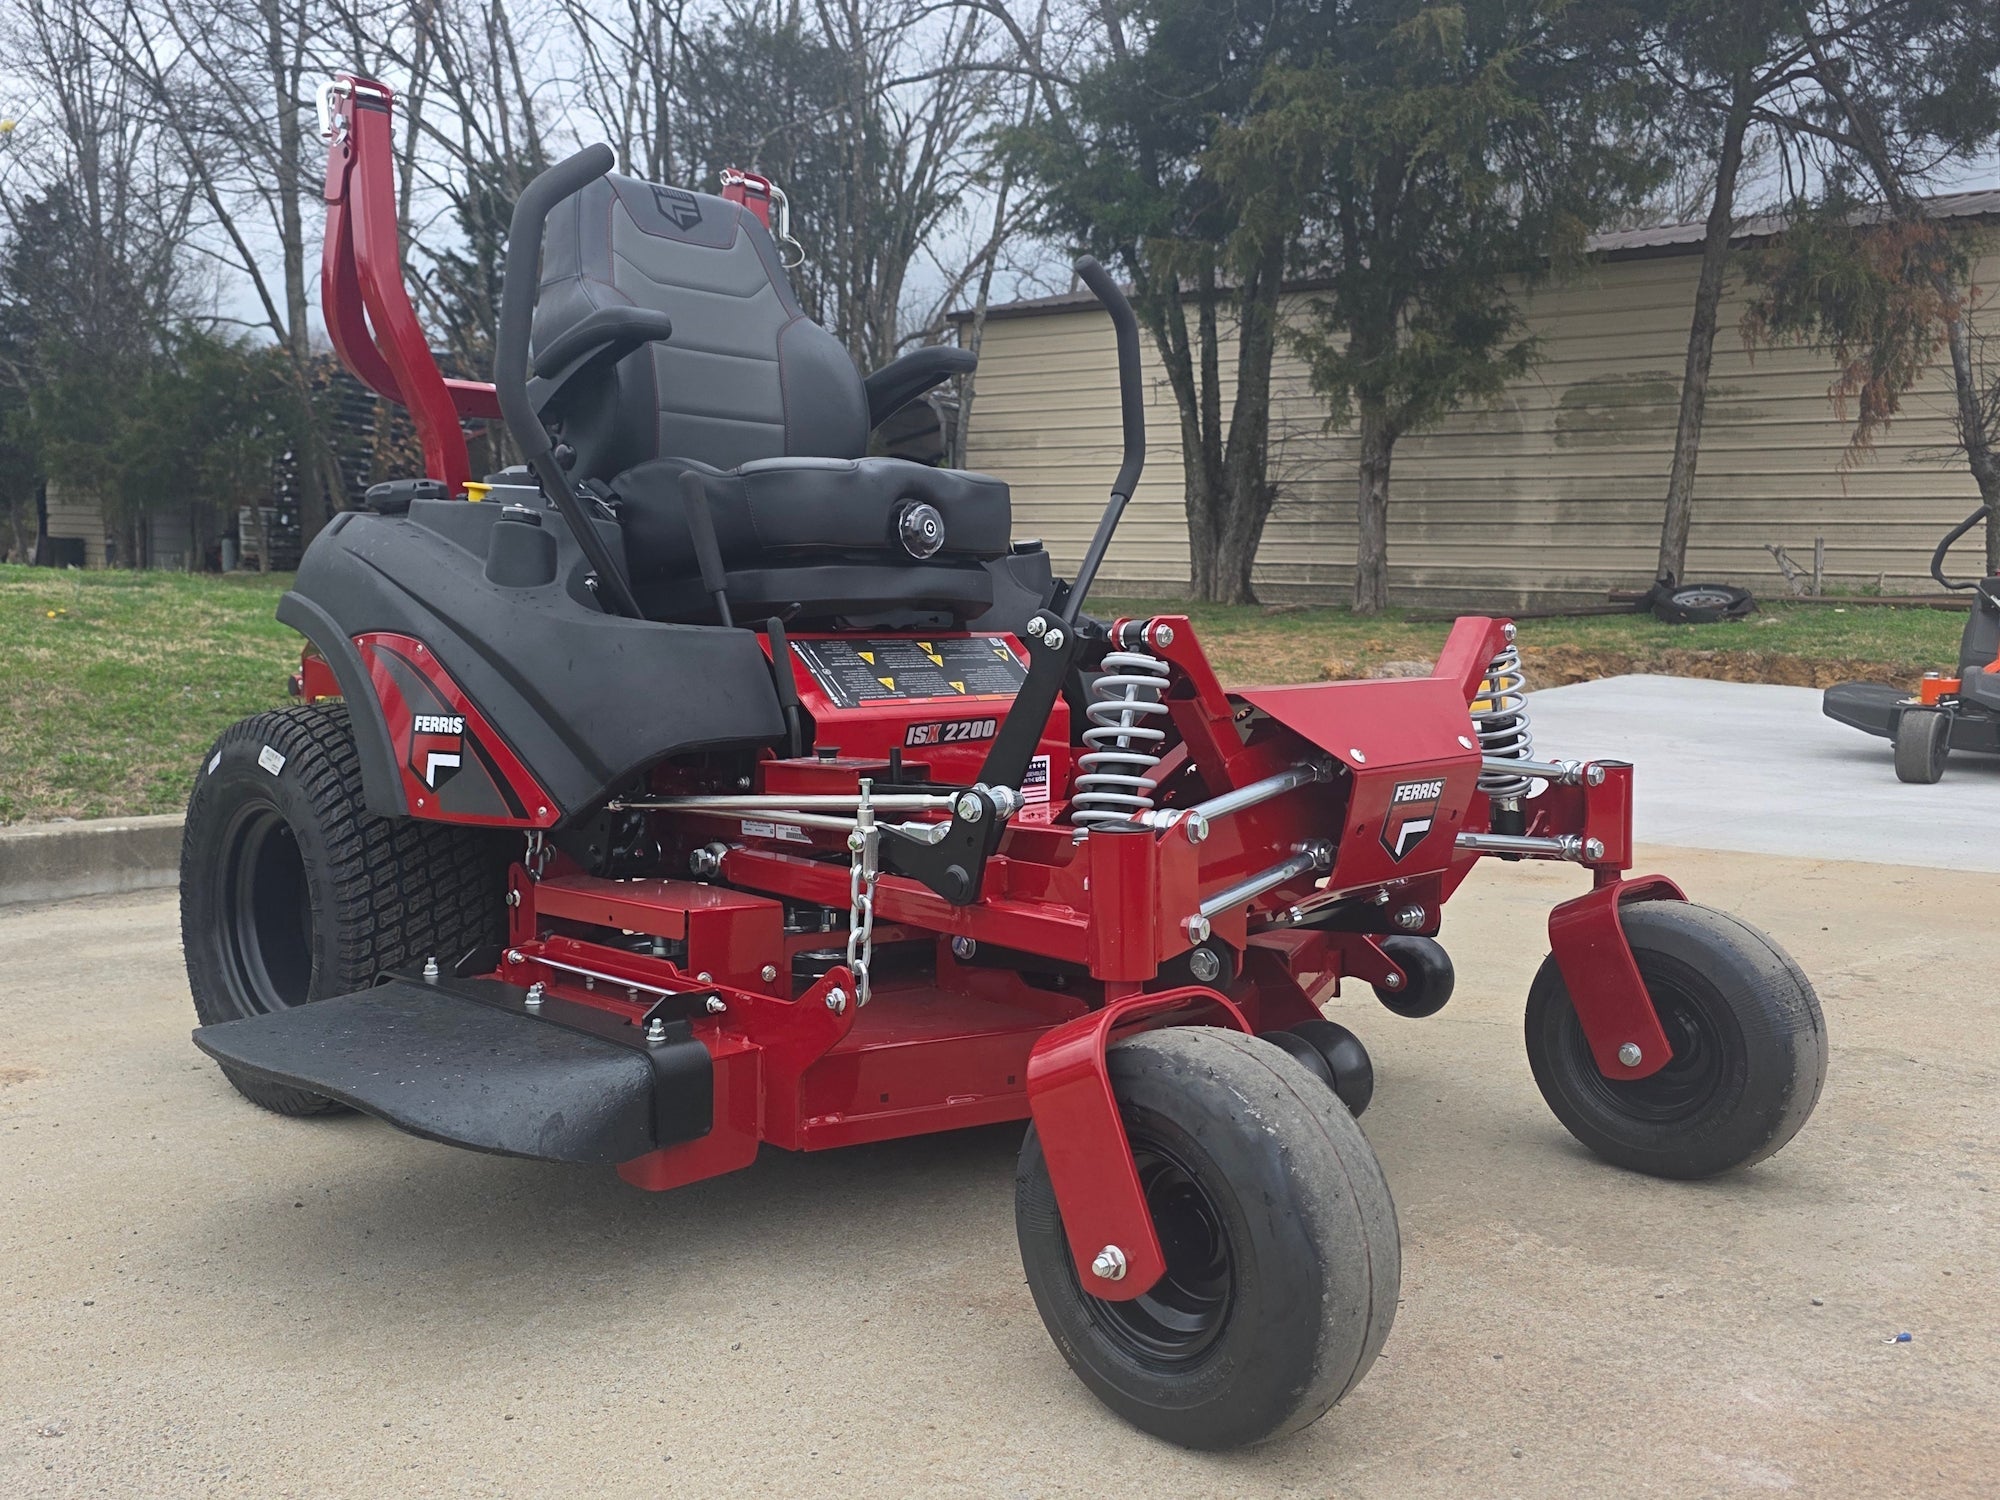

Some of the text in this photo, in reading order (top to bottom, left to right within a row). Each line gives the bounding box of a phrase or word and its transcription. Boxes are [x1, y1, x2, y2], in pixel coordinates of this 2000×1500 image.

[414, 715, 463, 734] FERRIS
[906, 719, 996, 746] ISX 2200
[1394, 781, 1442, 802] FERRIS
